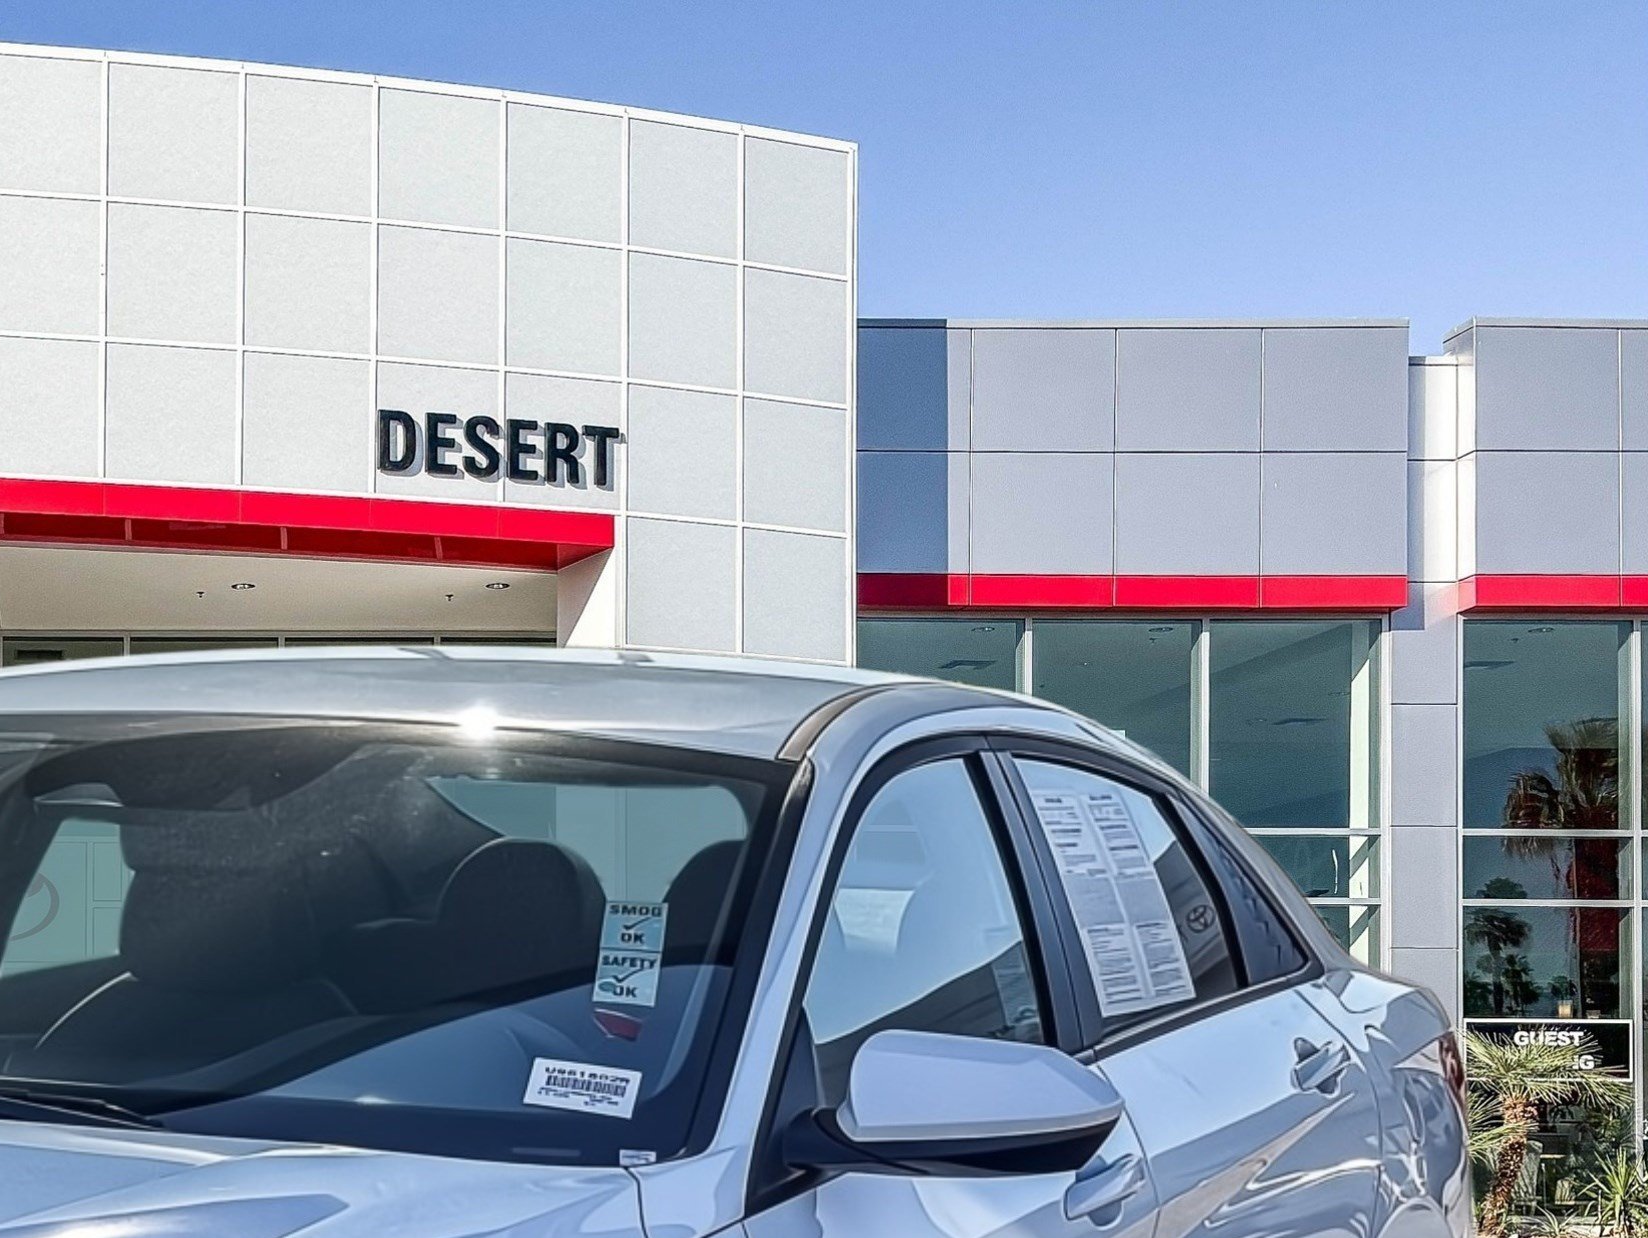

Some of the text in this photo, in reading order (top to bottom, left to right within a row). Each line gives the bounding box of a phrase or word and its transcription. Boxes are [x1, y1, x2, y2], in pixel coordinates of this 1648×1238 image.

[377, 409, 620, 486] DESERT
[609, 904, 662, 917] SMOG
[621, 932, 645, 944] OK
[602, 955, 656, 969] SAFETY
[612, 985, 638, 998] OK
[1513, 1030, 1584, 1047] GUEST
